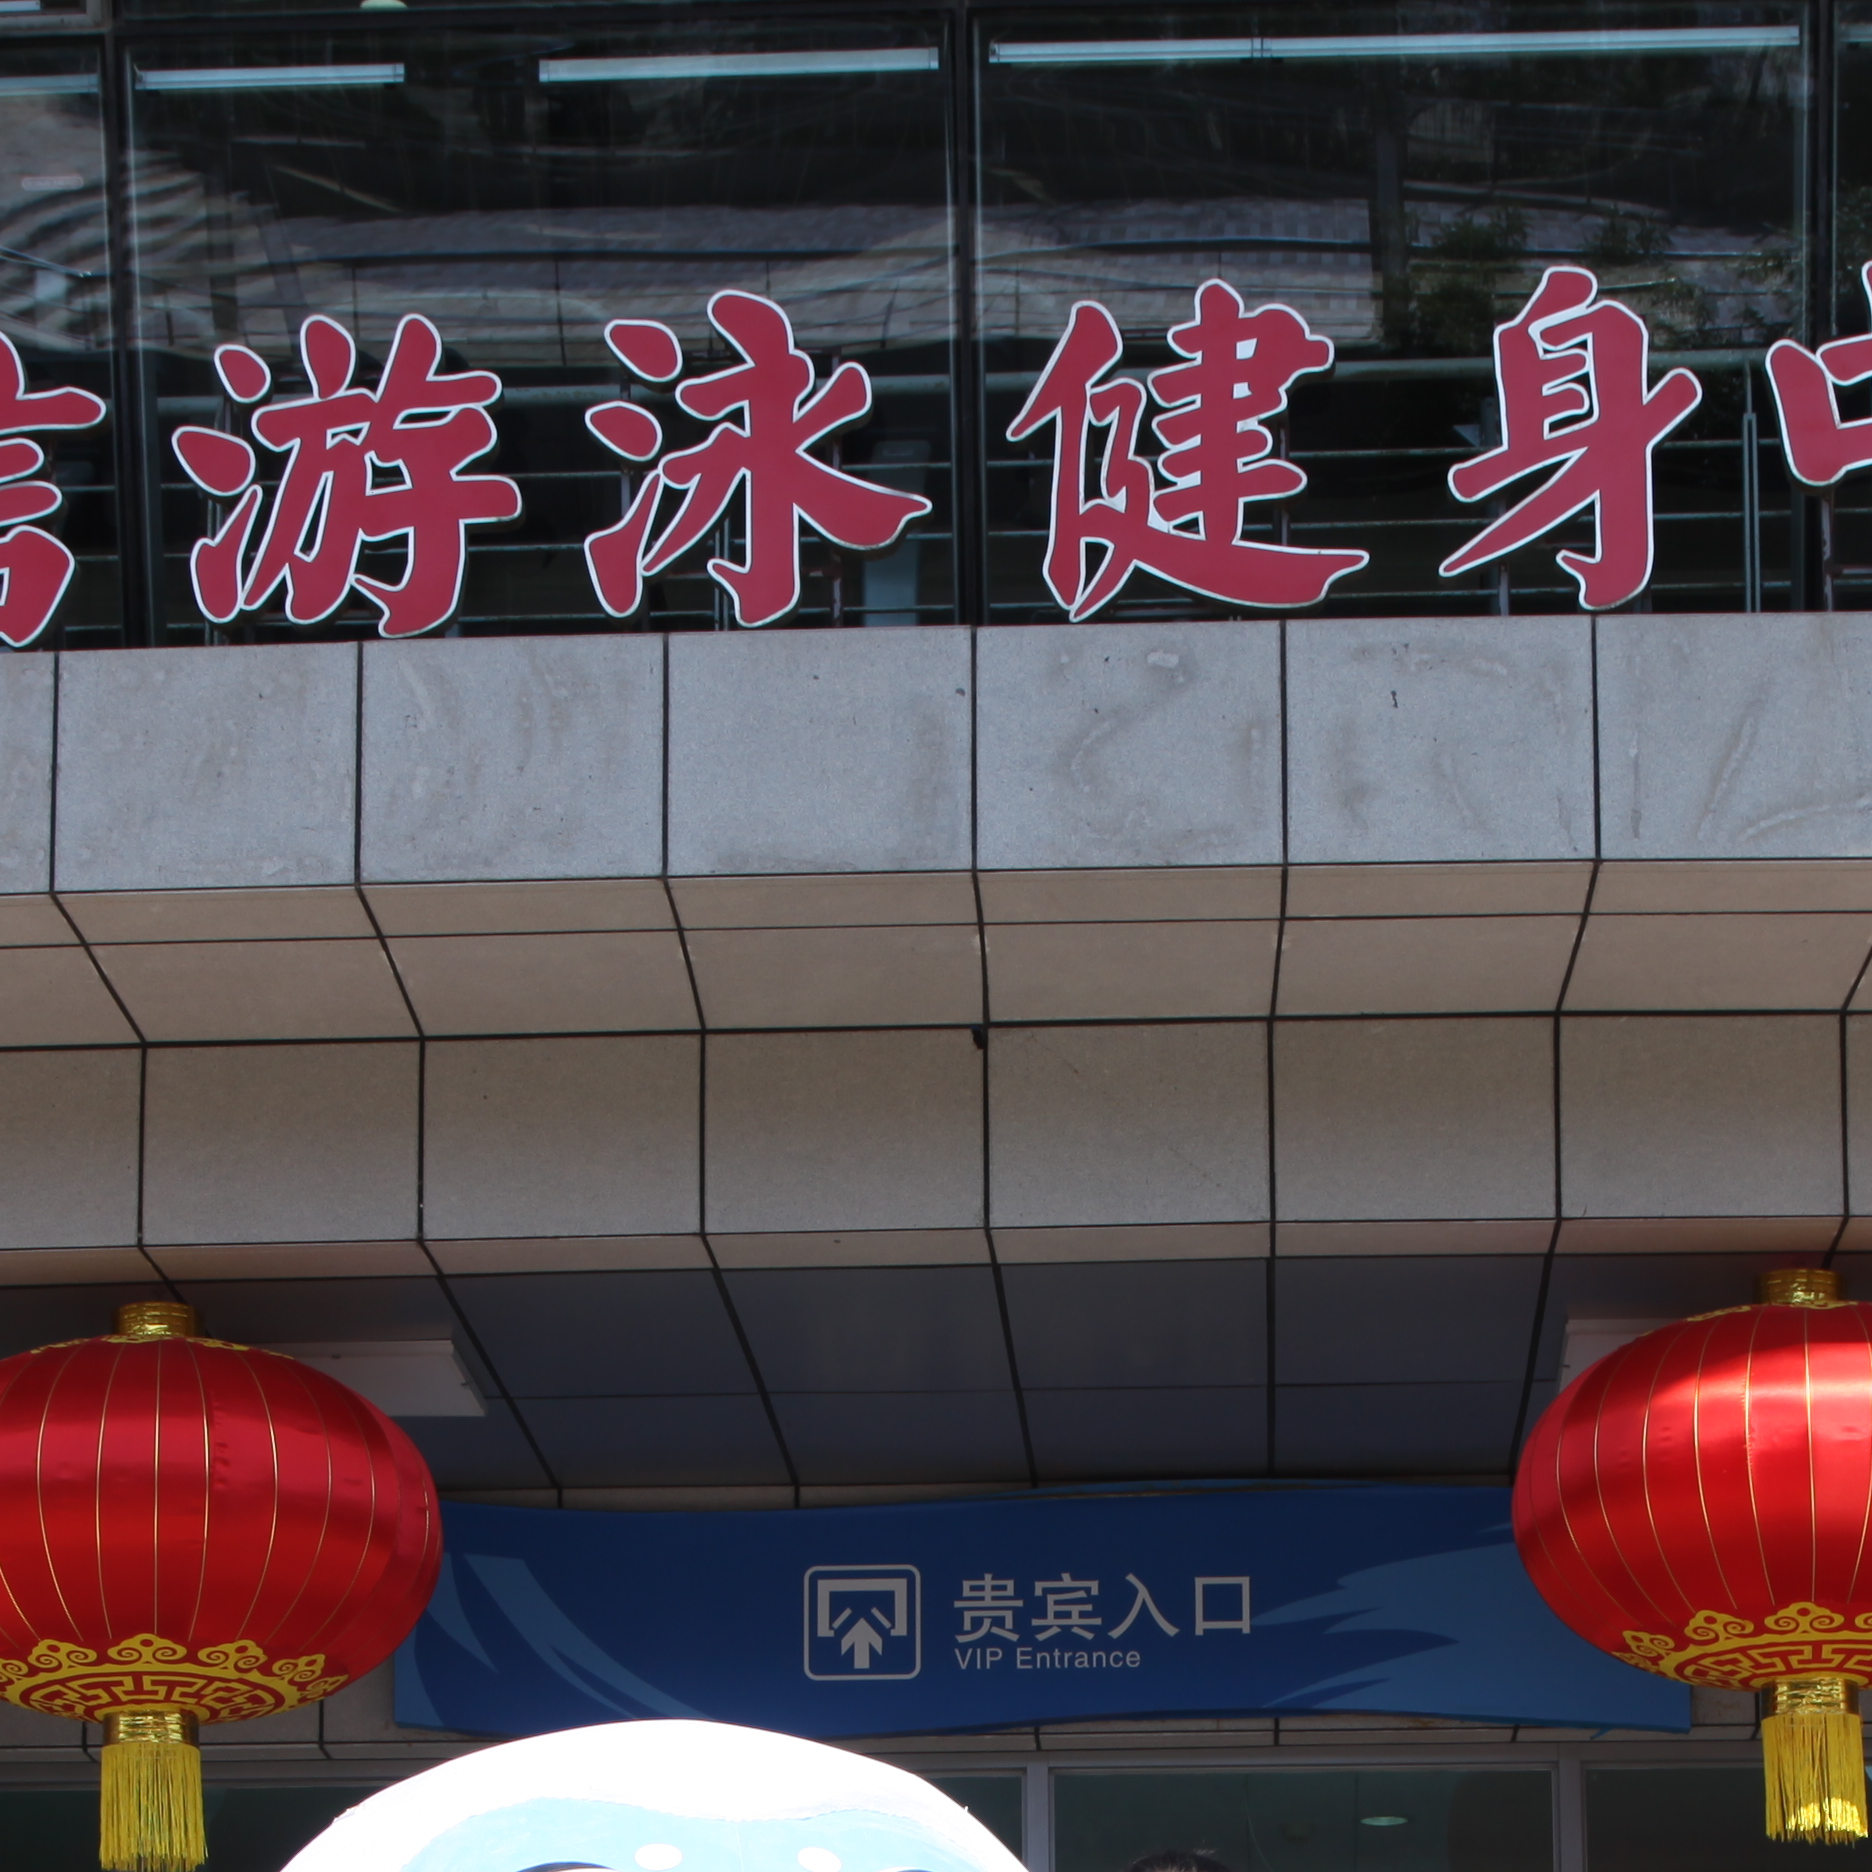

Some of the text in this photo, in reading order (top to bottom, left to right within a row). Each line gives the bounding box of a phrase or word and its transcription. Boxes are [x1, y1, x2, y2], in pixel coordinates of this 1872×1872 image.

[953, 1572, 1251, 1643] 贵宾入口
[954, 1646, 1142, 1670] VIP Entrance
